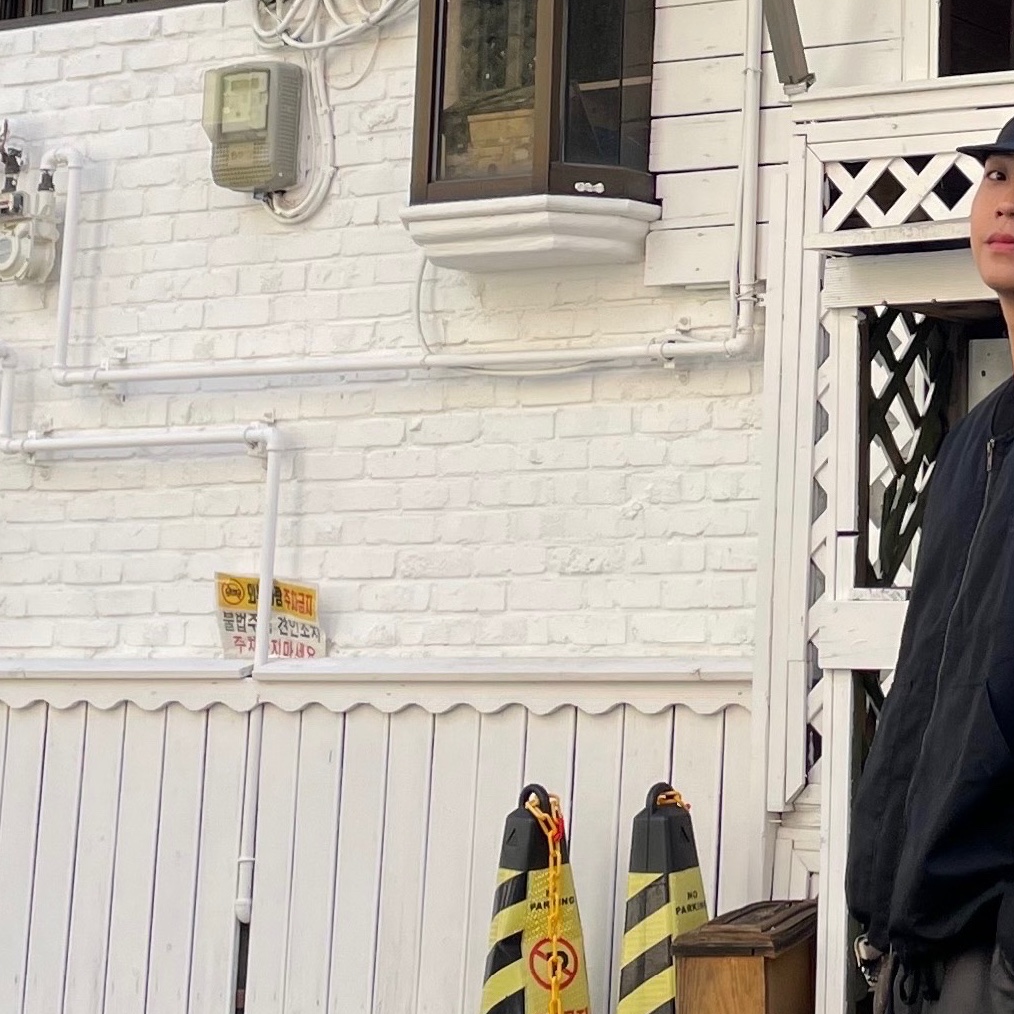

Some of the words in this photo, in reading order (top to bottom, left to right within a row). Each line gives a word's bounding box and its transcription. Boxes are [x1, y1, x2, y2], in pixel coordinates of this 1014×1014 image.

[247, 583, 283, 608] 외량
[283, 588, 313, 617] 주차금지
[223, 611, 272, 634] 불법주
[530, 896, 575, 911] PARING
